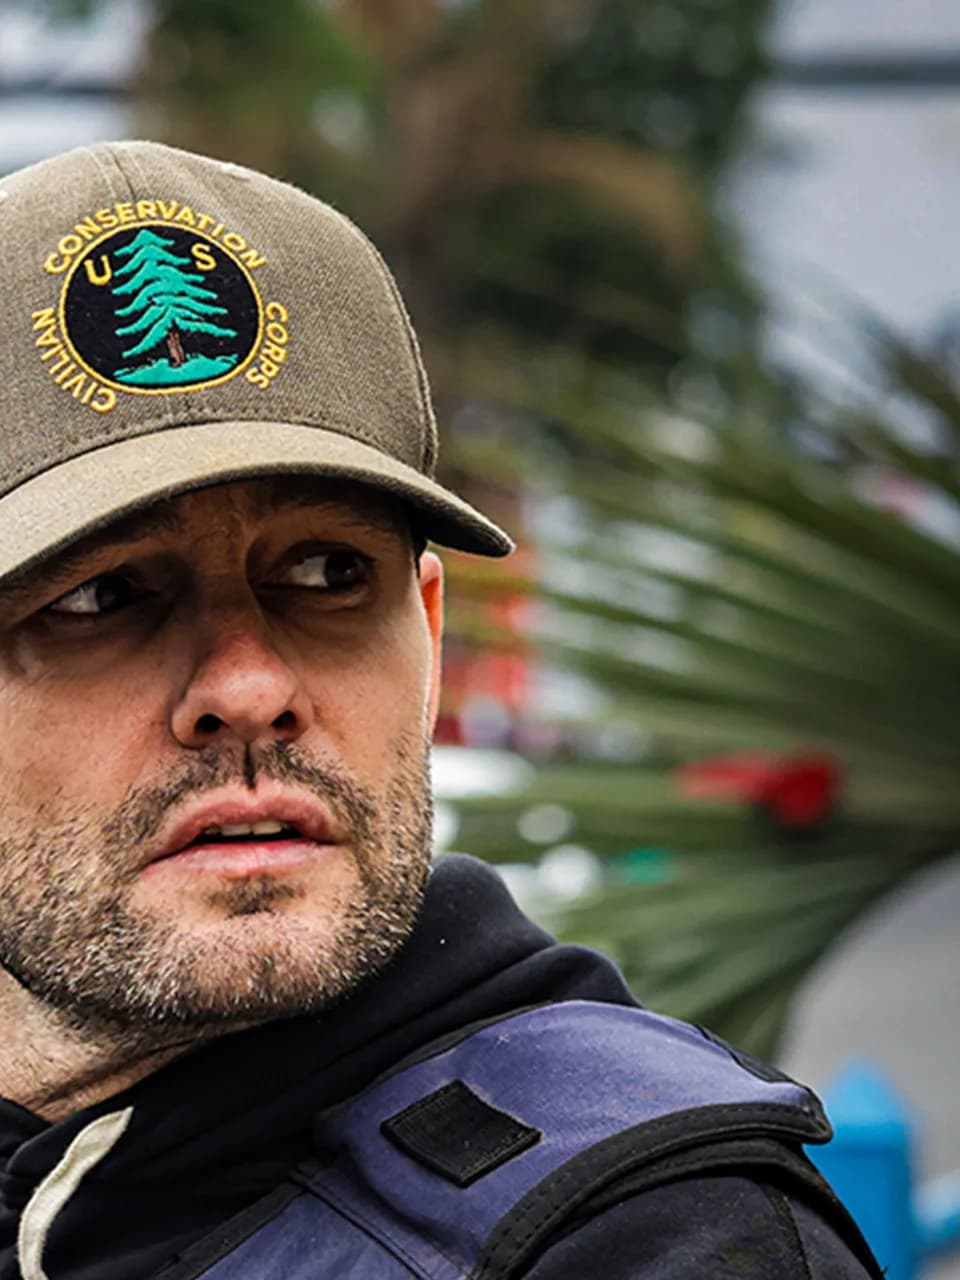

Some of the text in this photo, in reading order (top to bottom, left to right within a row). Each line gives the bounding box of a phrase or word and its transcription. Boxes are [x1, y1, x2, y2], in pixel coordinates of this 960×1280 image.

[31, 199, 289, 413] CIVILIAN CONSERVATION CORPS
[84, 243, 217, 285] U S
